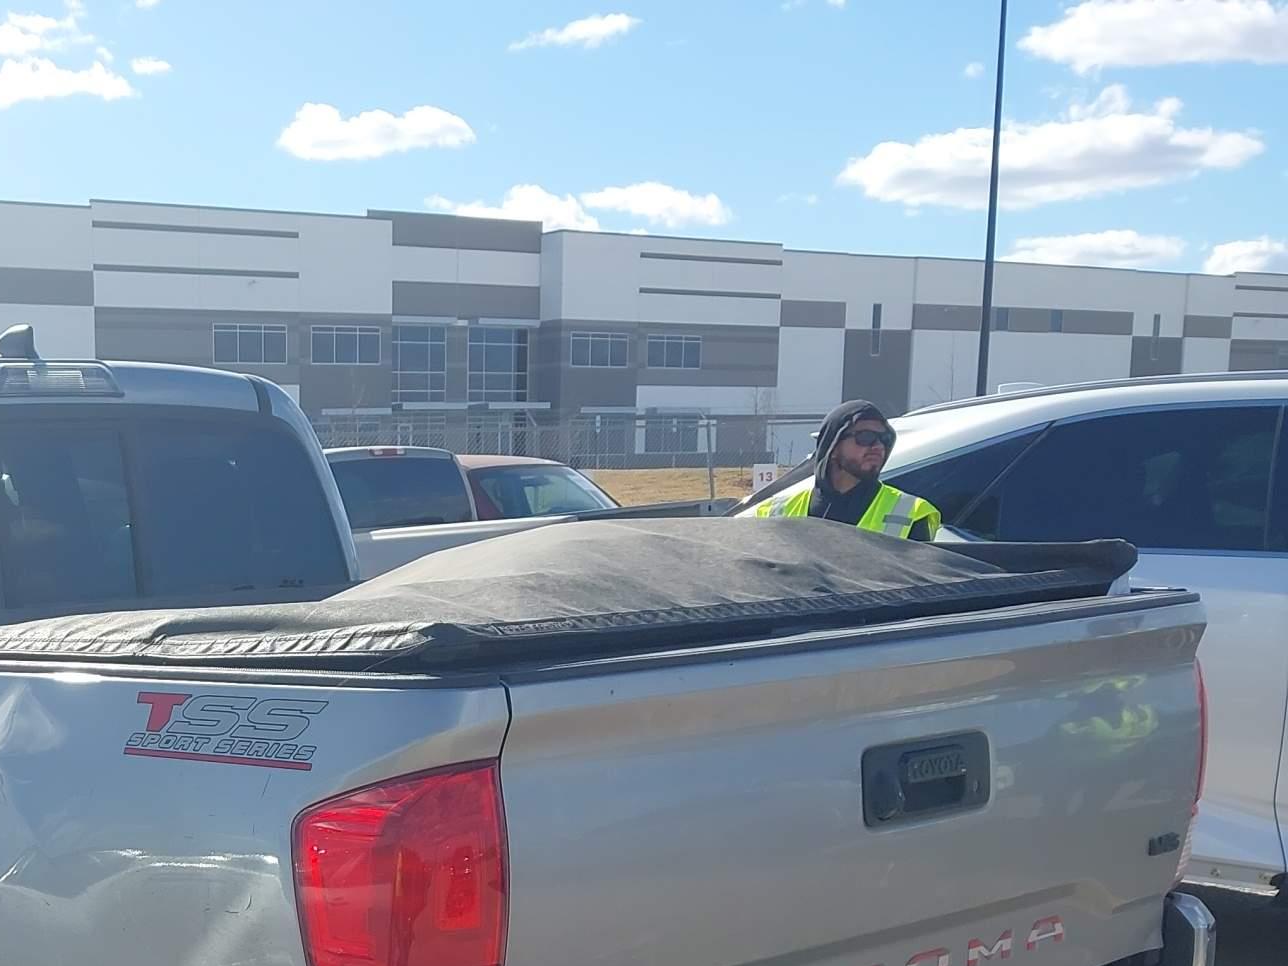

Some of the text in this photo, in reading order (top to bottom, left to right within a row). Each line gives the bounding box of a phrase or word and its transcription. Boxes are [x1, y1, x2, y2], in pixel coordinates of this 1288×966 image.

[759, 471, 774, 482] 13
[136, 691, 330, 742] TSS
[125, 732, 318, 761] SPORT SERIES
